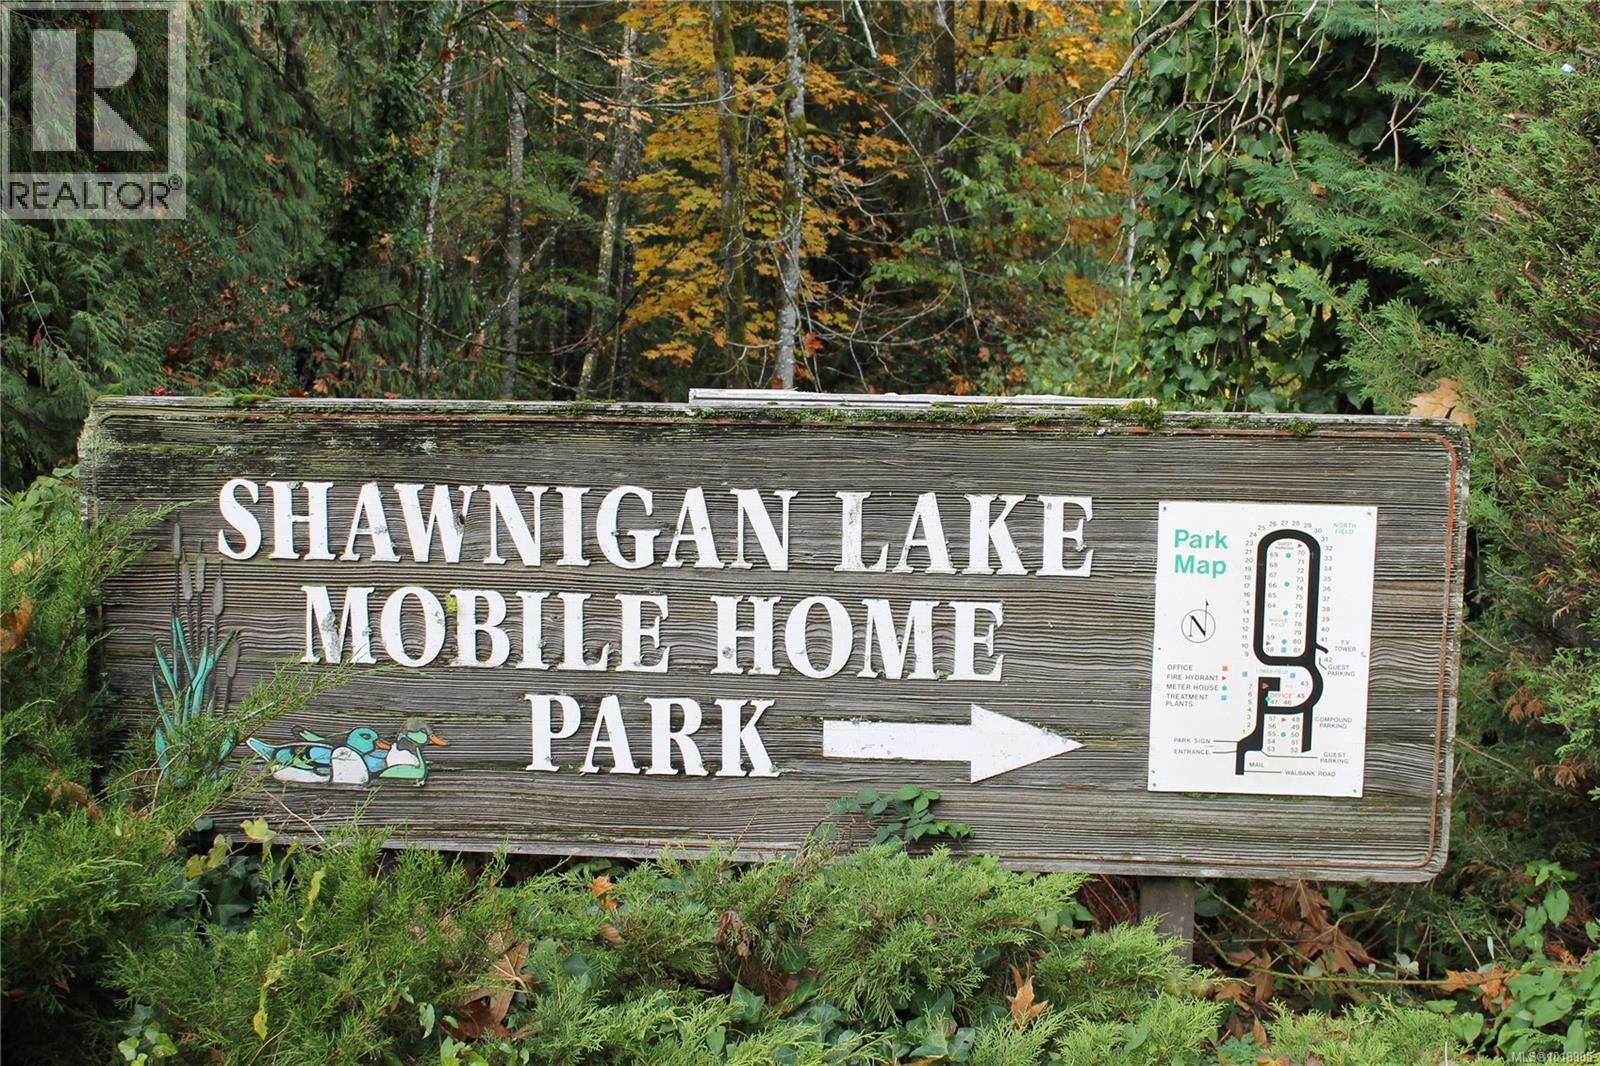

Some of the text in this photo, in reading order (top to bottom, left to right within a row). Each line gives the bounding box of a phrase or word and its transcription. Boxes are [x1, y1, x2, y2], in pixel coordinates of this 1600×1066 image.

[217, 478, 1093, 578] SHAWNIGAN LAKE
[1174, 528, 1228, 549] Park
[1174, 554, 1227, 579] Map
[300, 585, 1004, 682] MOBILE HOME
[524, 694, 781, 778] PARK
